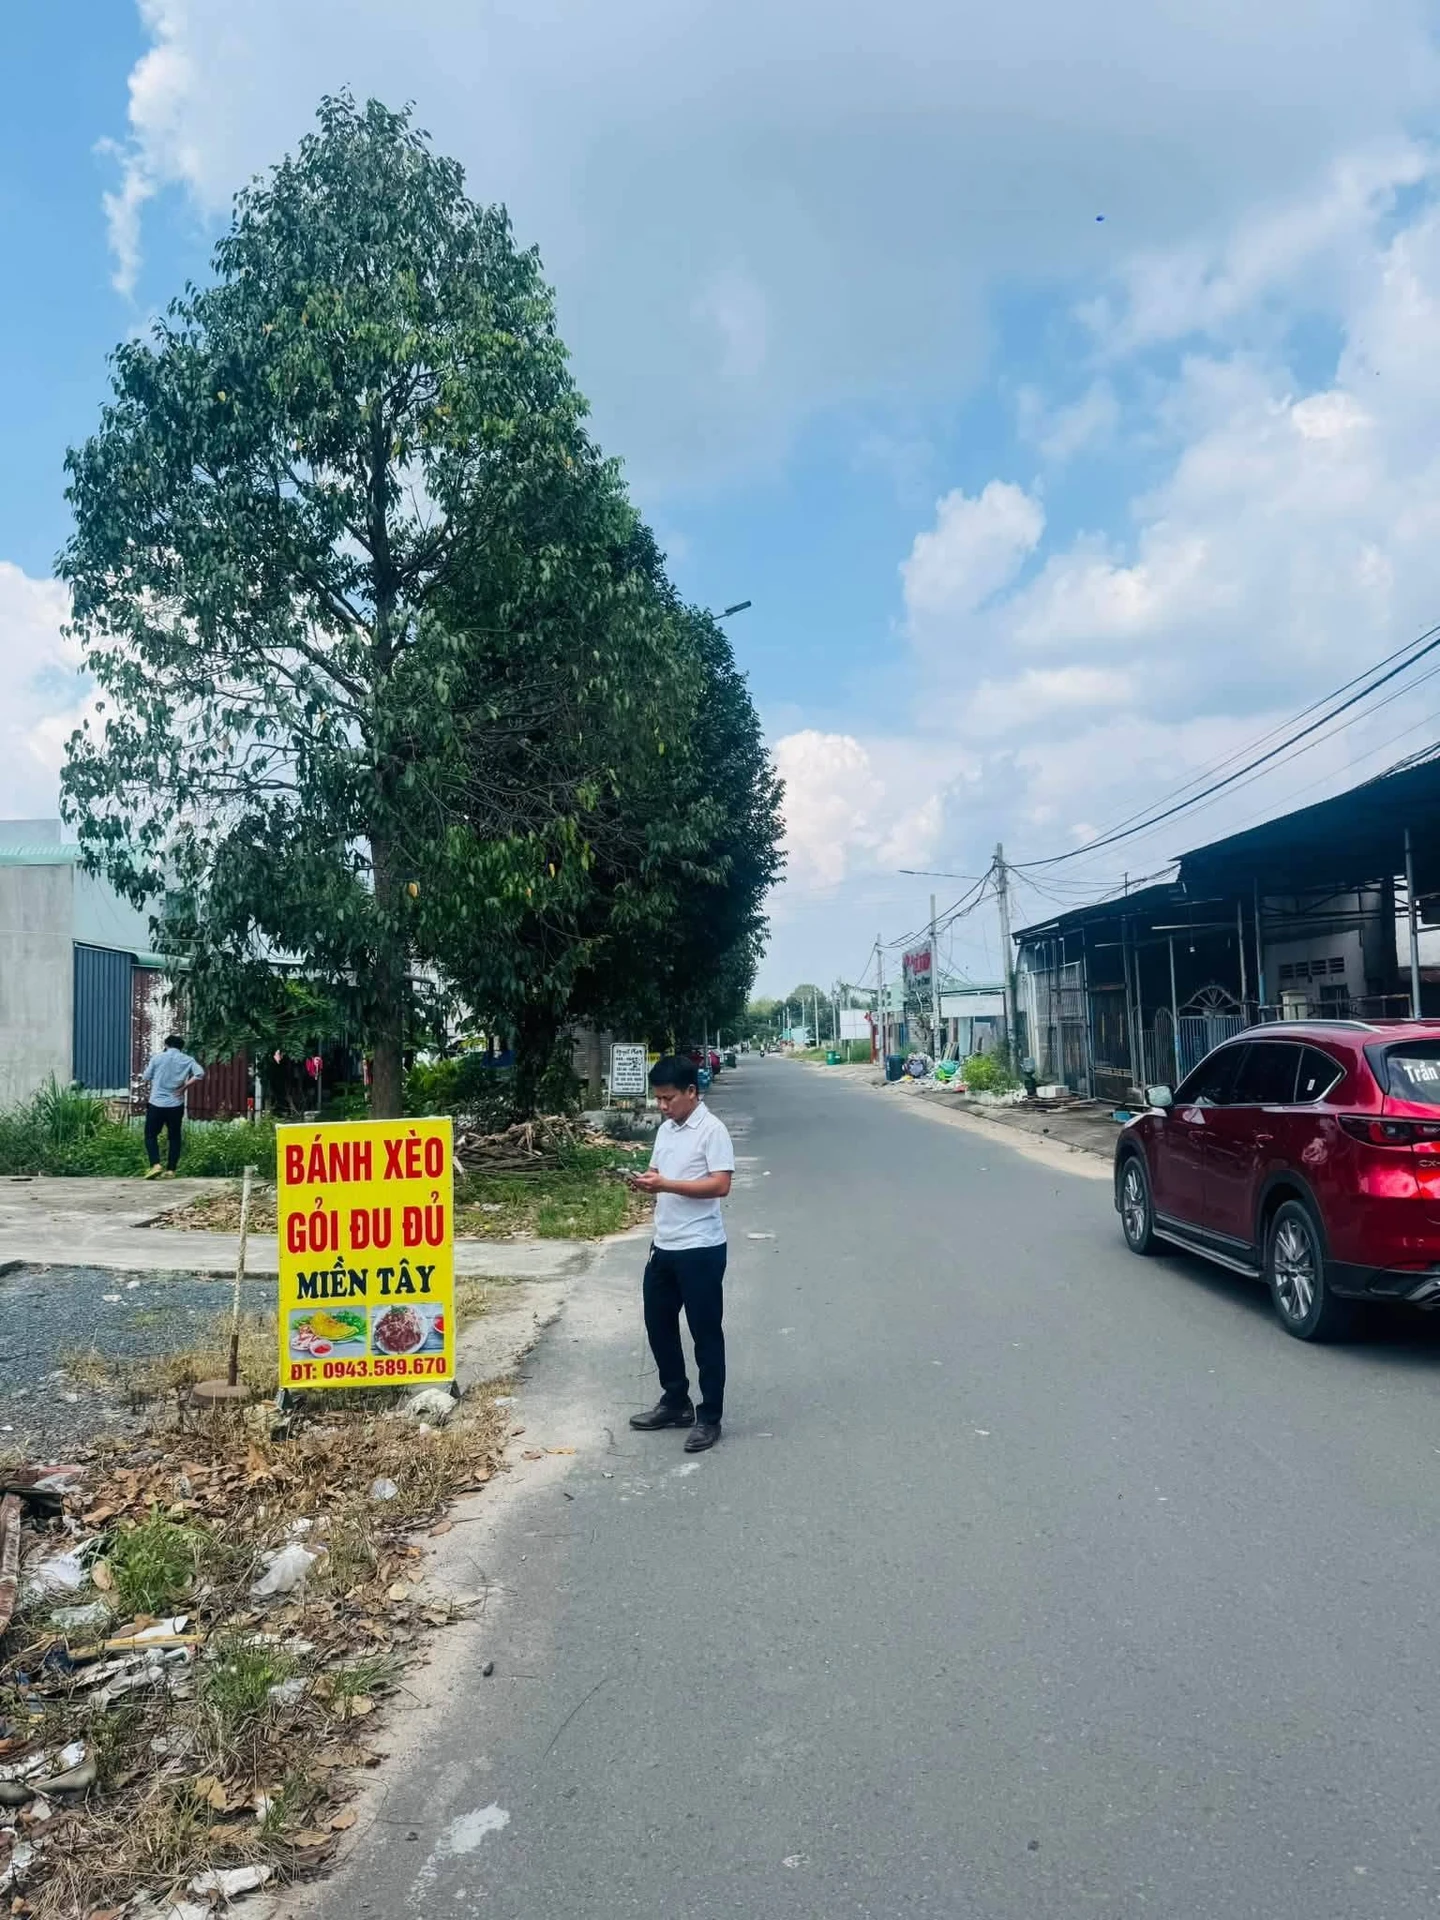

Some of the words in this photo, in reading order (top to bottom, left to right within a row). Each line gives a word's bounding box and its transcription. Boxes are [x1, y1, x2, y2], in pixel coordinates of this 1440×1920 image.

[286, 1134, 372, 1185] BÁNH
[384, 1130, 443, 1180] XÈO
[287, 1197, 338, 1253] GỎI
[350, 1207, 391, 1250] ĐU
[402, 1191, 444, 1247] ĐỦ
[296, 1256, 368, 1299] MIỀN
[376, 1258, 435, 1295] TÂY
[291, 1364, 317, 1381] ĐT:
[323, 1357, 446, 1379] 0943.589.670
